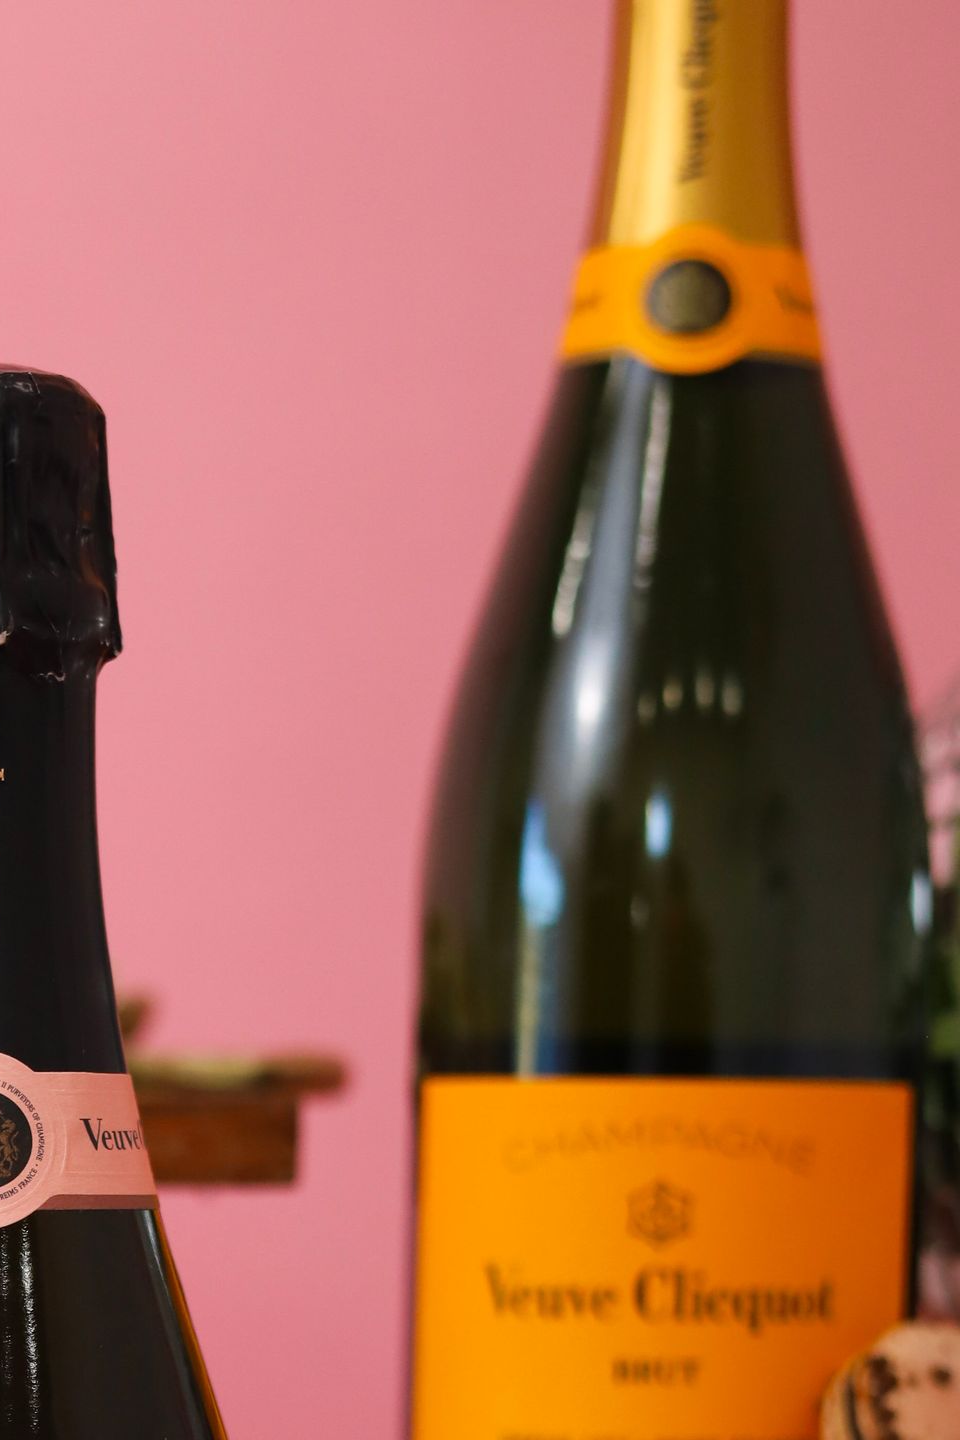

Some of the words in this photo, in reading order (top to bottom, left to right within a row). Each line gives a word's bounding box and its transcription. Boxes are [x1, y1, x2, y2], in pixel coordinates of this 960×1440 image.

[7, 1084, 36, 1113] PURVEYORS
[32, 1112, 41, 1121] OF
[36, 1122, 46, 1162] CHAMPAGNE
[79, 1117, 140, 1151] Veuve
[0, 1186, 19, 1200] REIMS
[17, 1167, 38, 1190] FRANCE
[485, 1260, 617, 1320] Veuve
[632, 1265, 834, 1337] Clicquot
